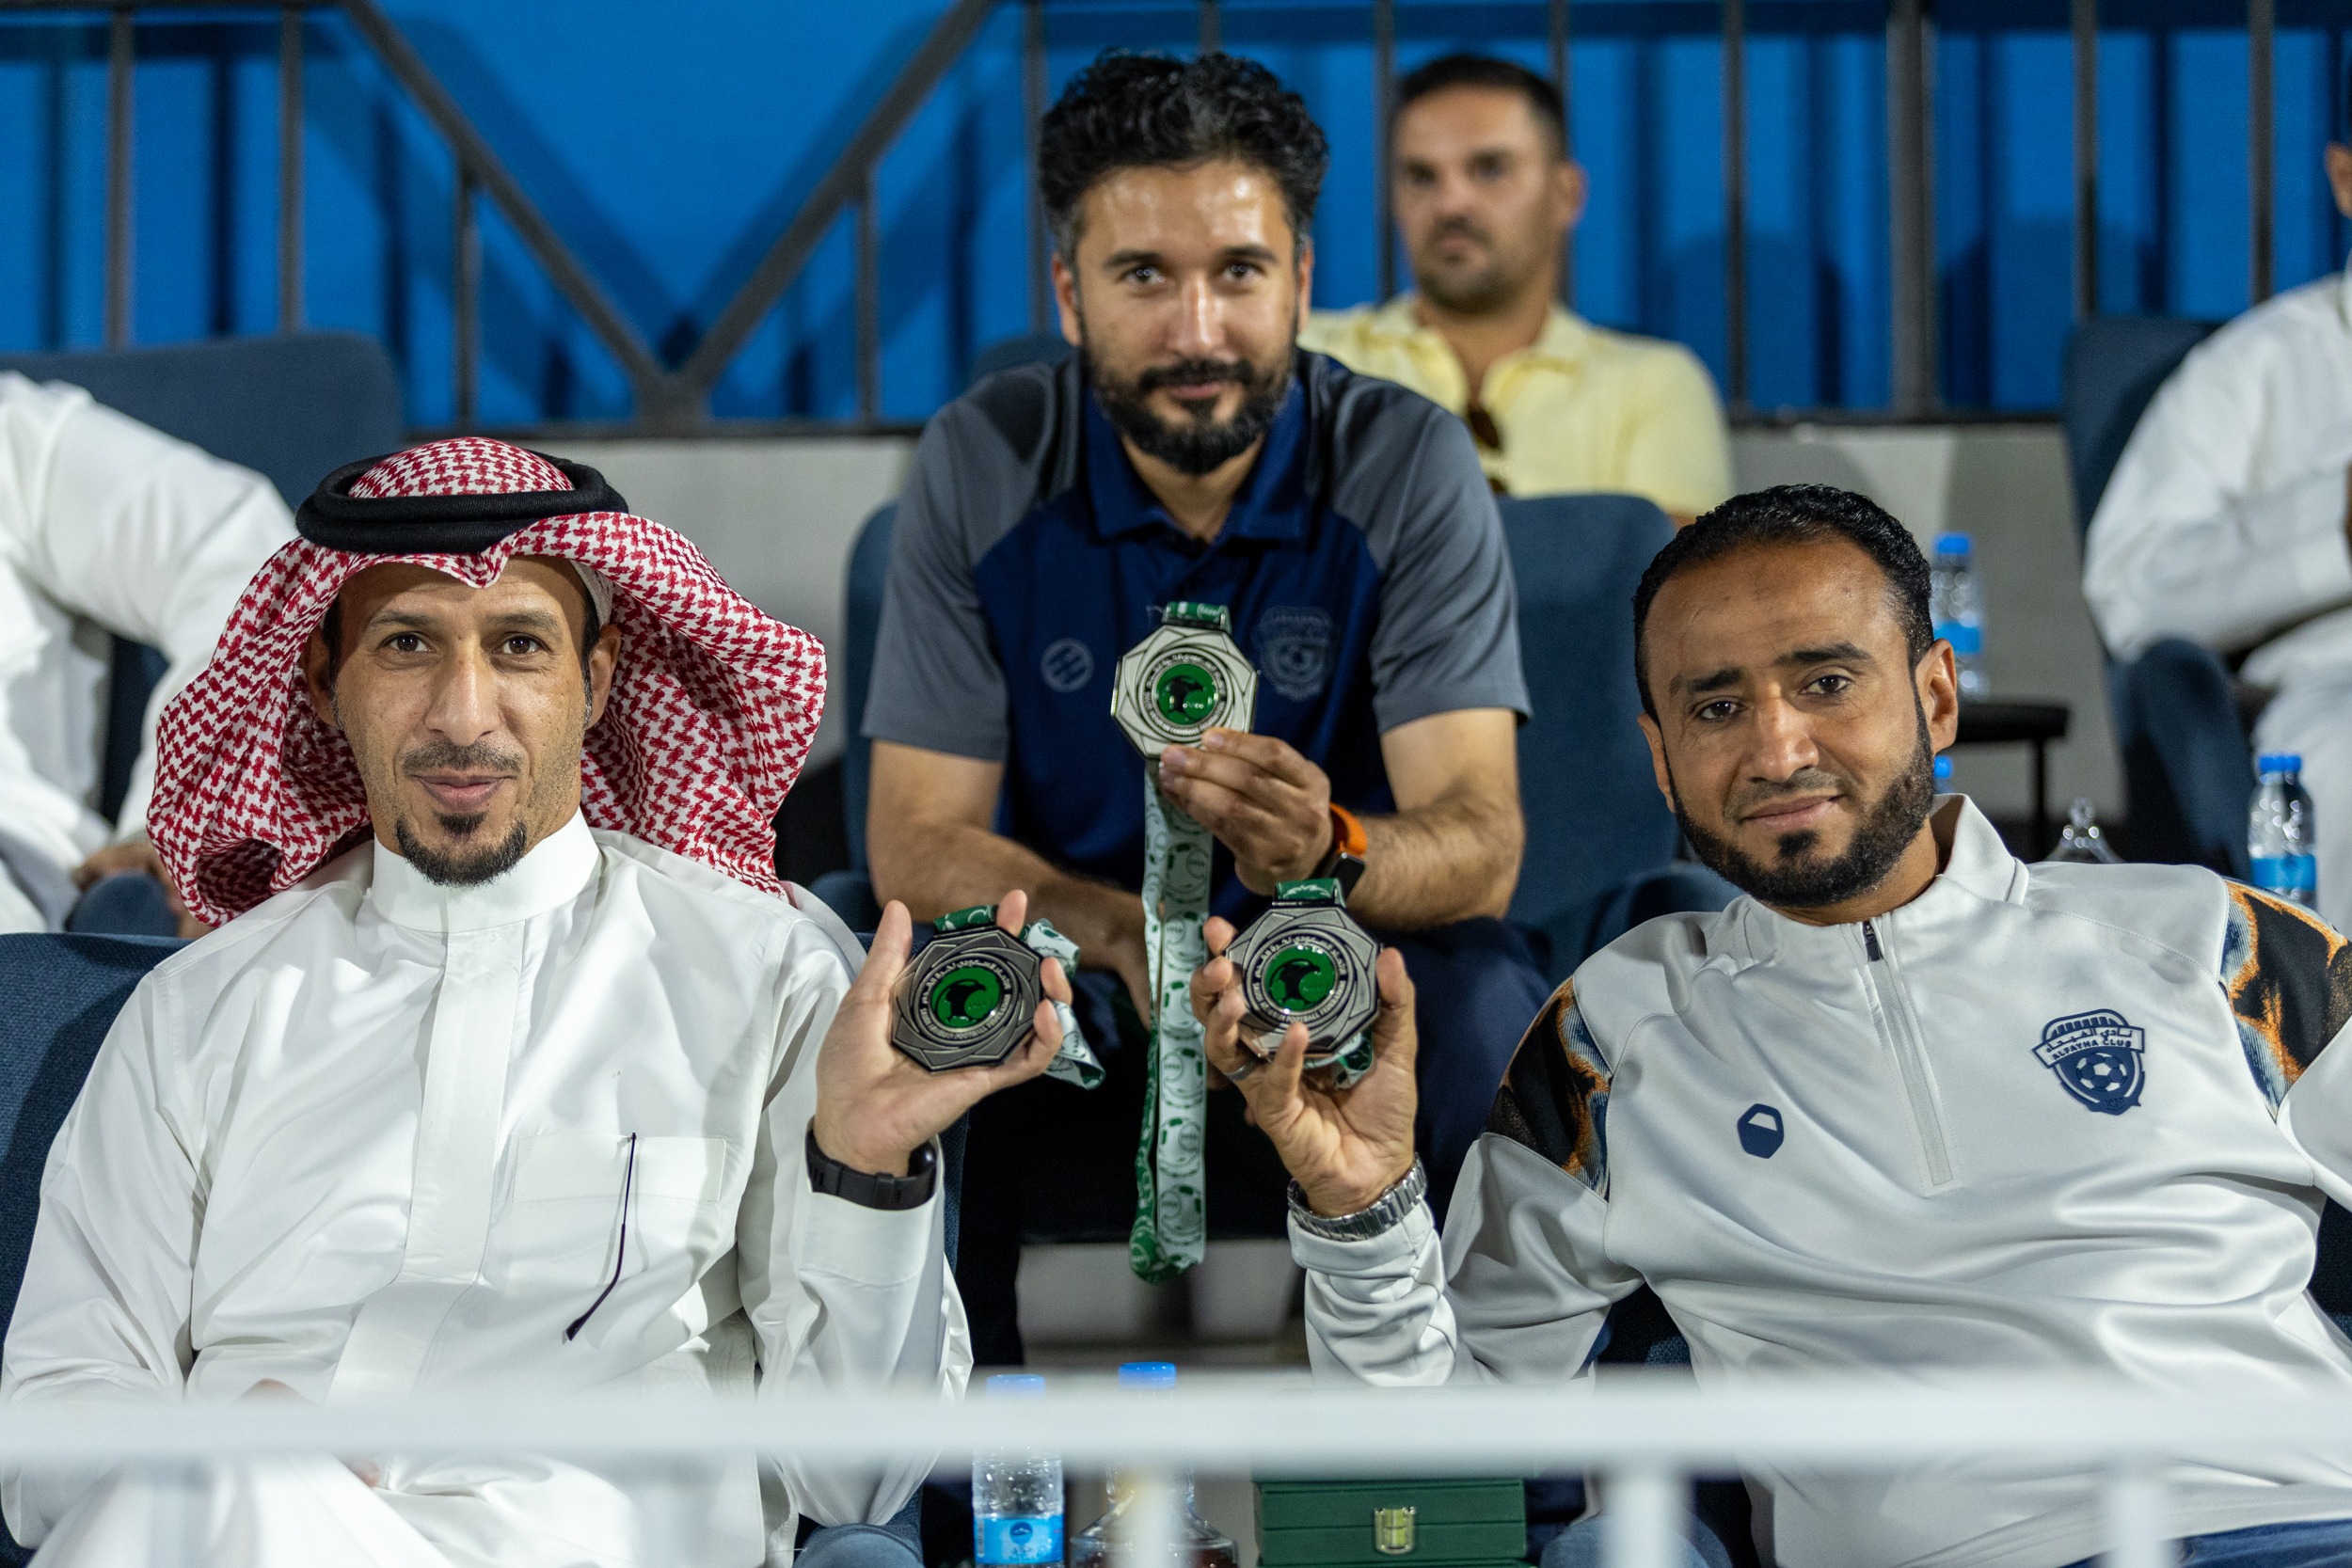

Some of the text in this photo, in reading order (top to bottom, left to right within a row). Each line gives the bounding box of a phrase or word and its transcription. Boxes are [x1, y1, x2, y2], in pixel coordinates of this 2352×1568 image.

[2100, 1027, 2133, 1040] نادي
[2052, 1038, 2132, 1060] ALFAYHA CLUB
